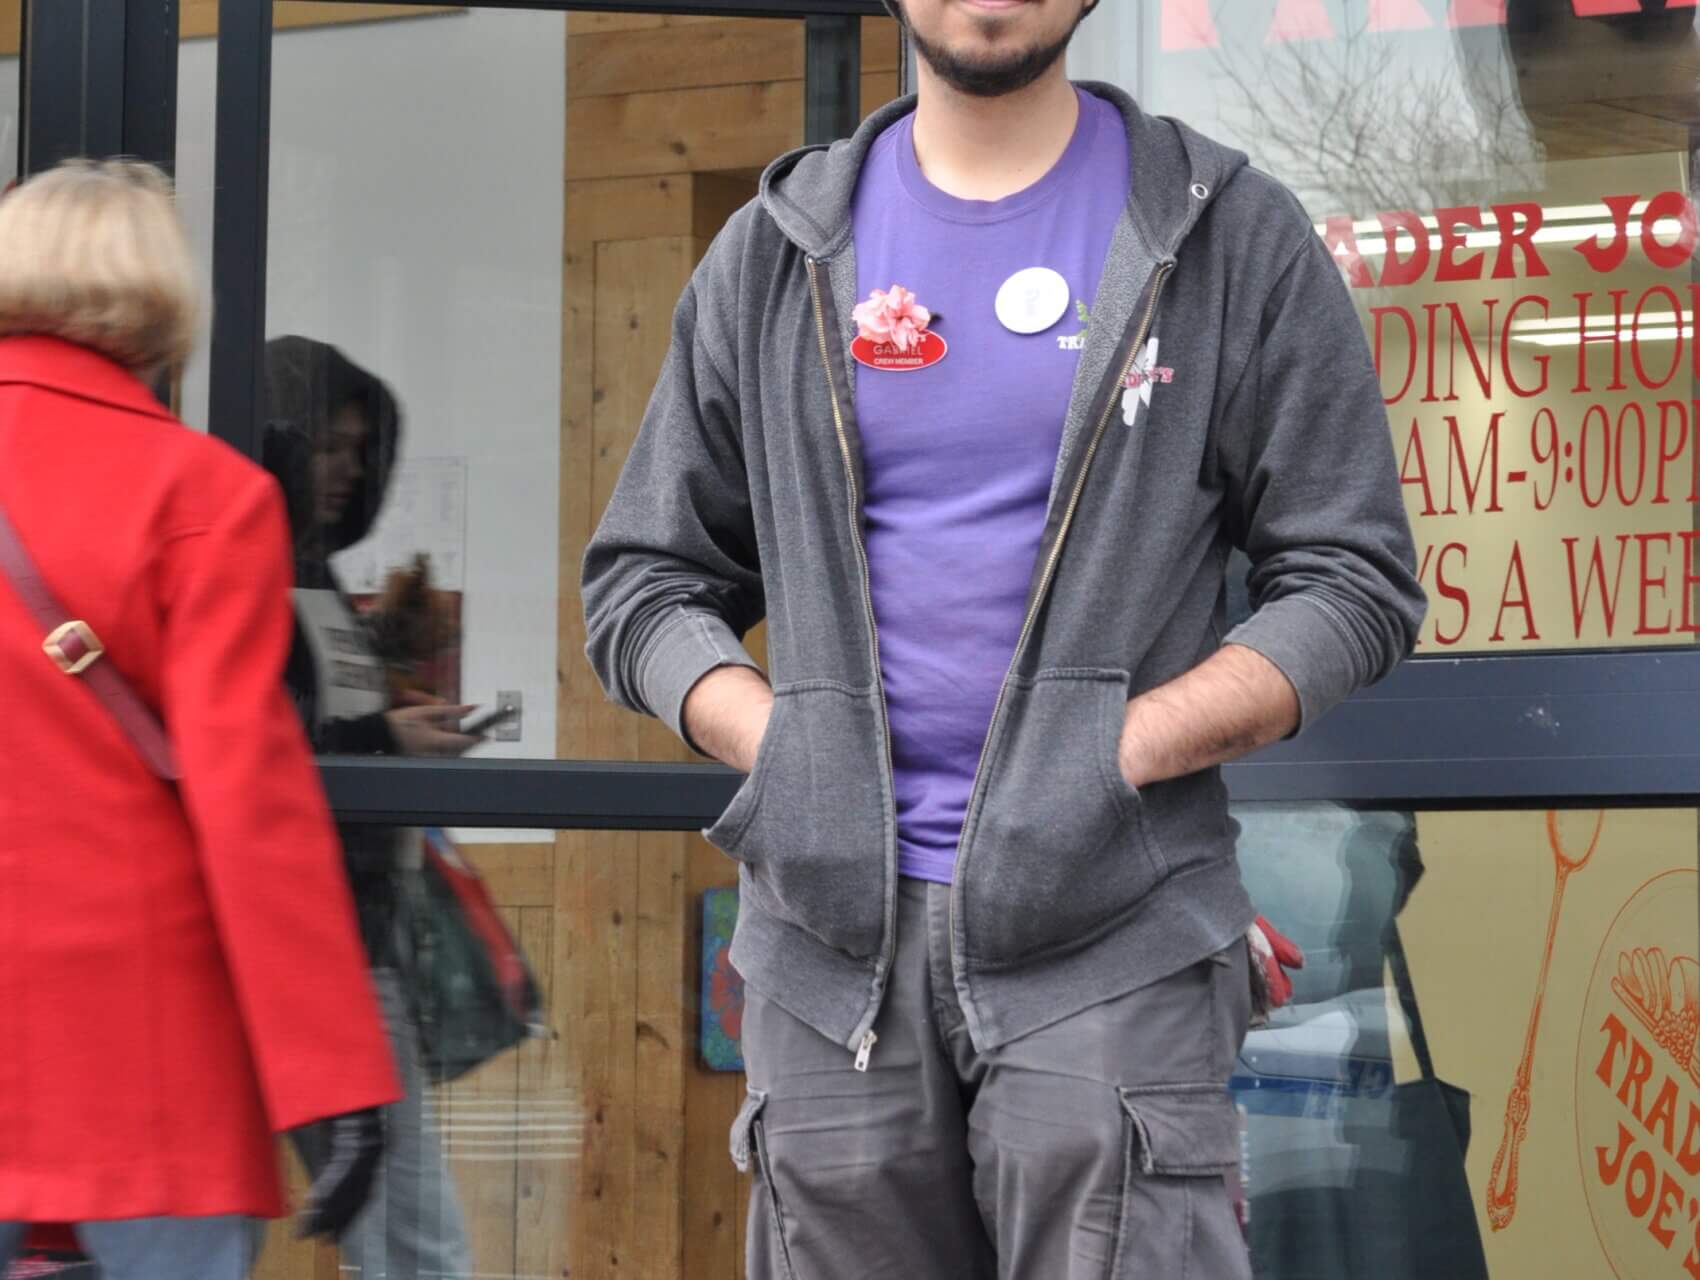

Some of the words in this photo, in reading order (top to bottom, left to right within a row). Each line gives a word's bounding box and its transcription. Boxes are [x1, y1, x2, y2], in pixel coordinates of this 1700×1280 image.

[1573, 191, 1697, 273] JO
[1369, 294, 1551, 406] DING
[1571, 284, 1700, 394] HO
[1400, 399, 1700, 517] AM-9:00P
[1488, 539, 1541, 642] A
